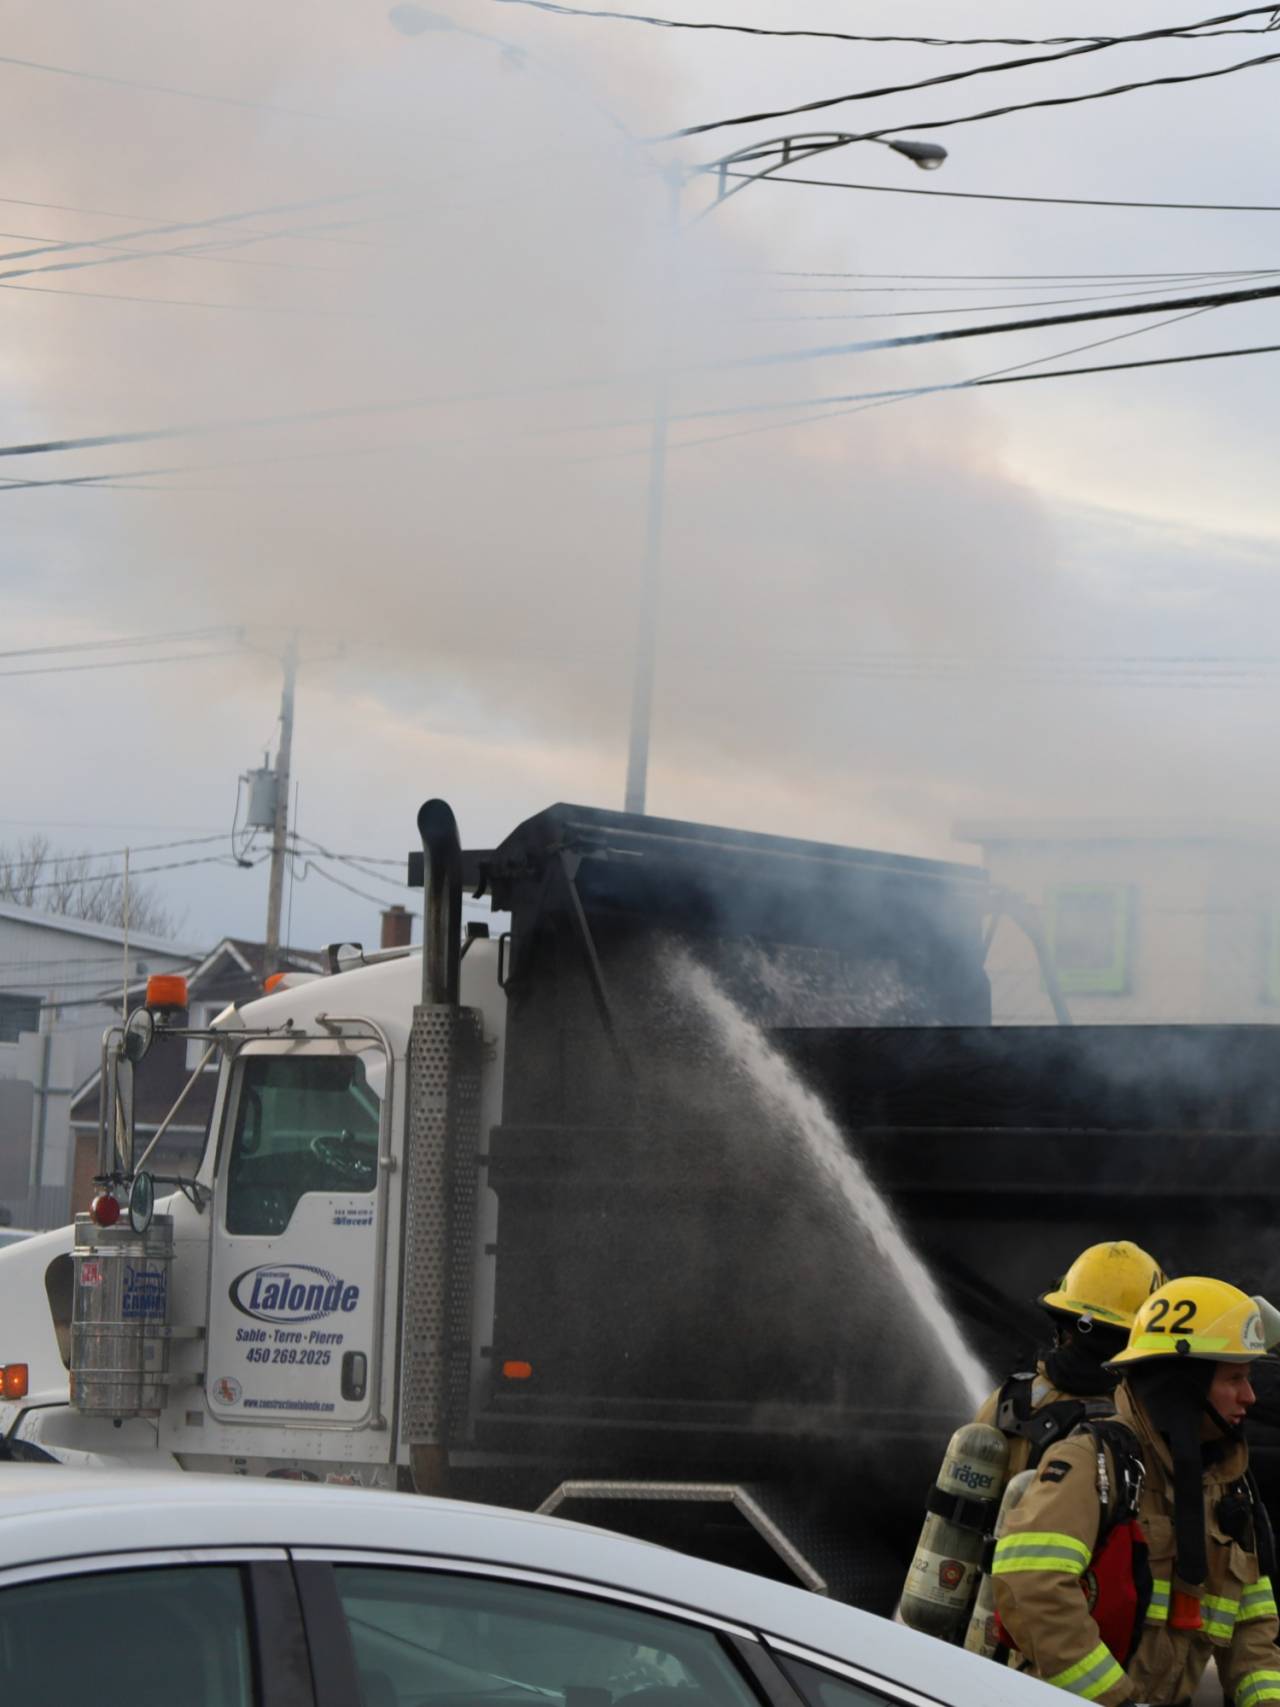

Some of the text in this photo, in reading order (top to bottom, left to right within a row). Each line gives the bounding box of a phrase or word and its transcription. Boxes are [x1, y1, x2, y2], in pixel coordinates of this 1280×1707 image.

[248, 1277, 360, 1313] Lalonde
[1145, 1299, 1198, 1335] 22
[235, 1327, 345, 1346] Sable Terre Pierre
[246, 1347, 332, 1366] 450 269.2025
